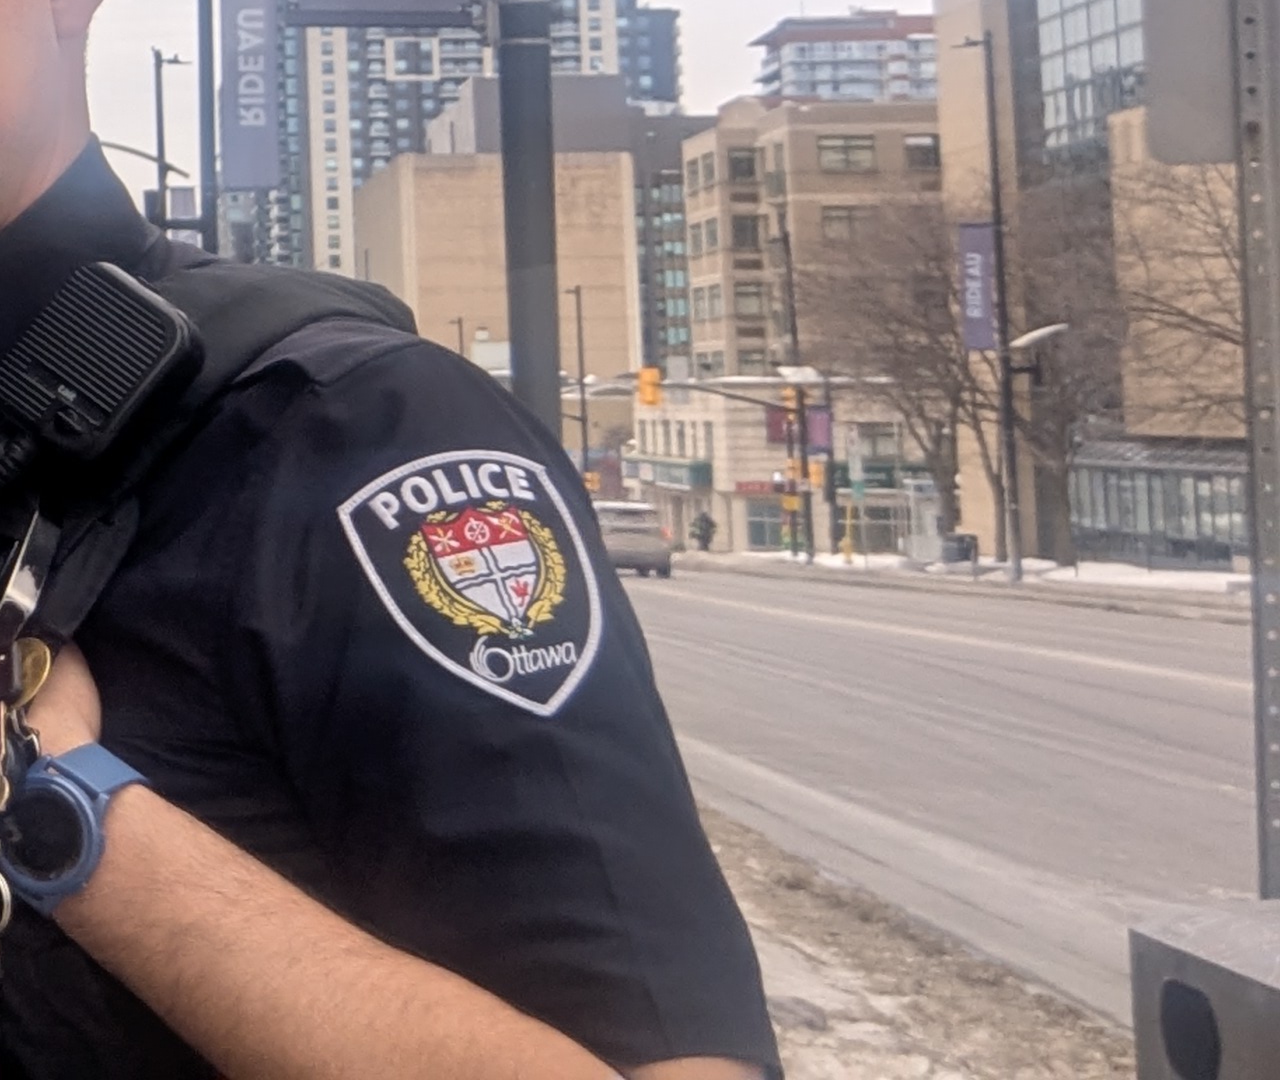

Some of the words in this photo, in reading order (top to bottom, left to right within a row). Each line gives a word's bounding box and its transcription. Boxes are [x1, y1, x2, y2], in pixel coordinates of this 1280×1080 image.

[965, 252, 983, 318] RIDEAU
[368, 462, 536, 530] POLICE
[469, 636, 578, 683] Ottawa
